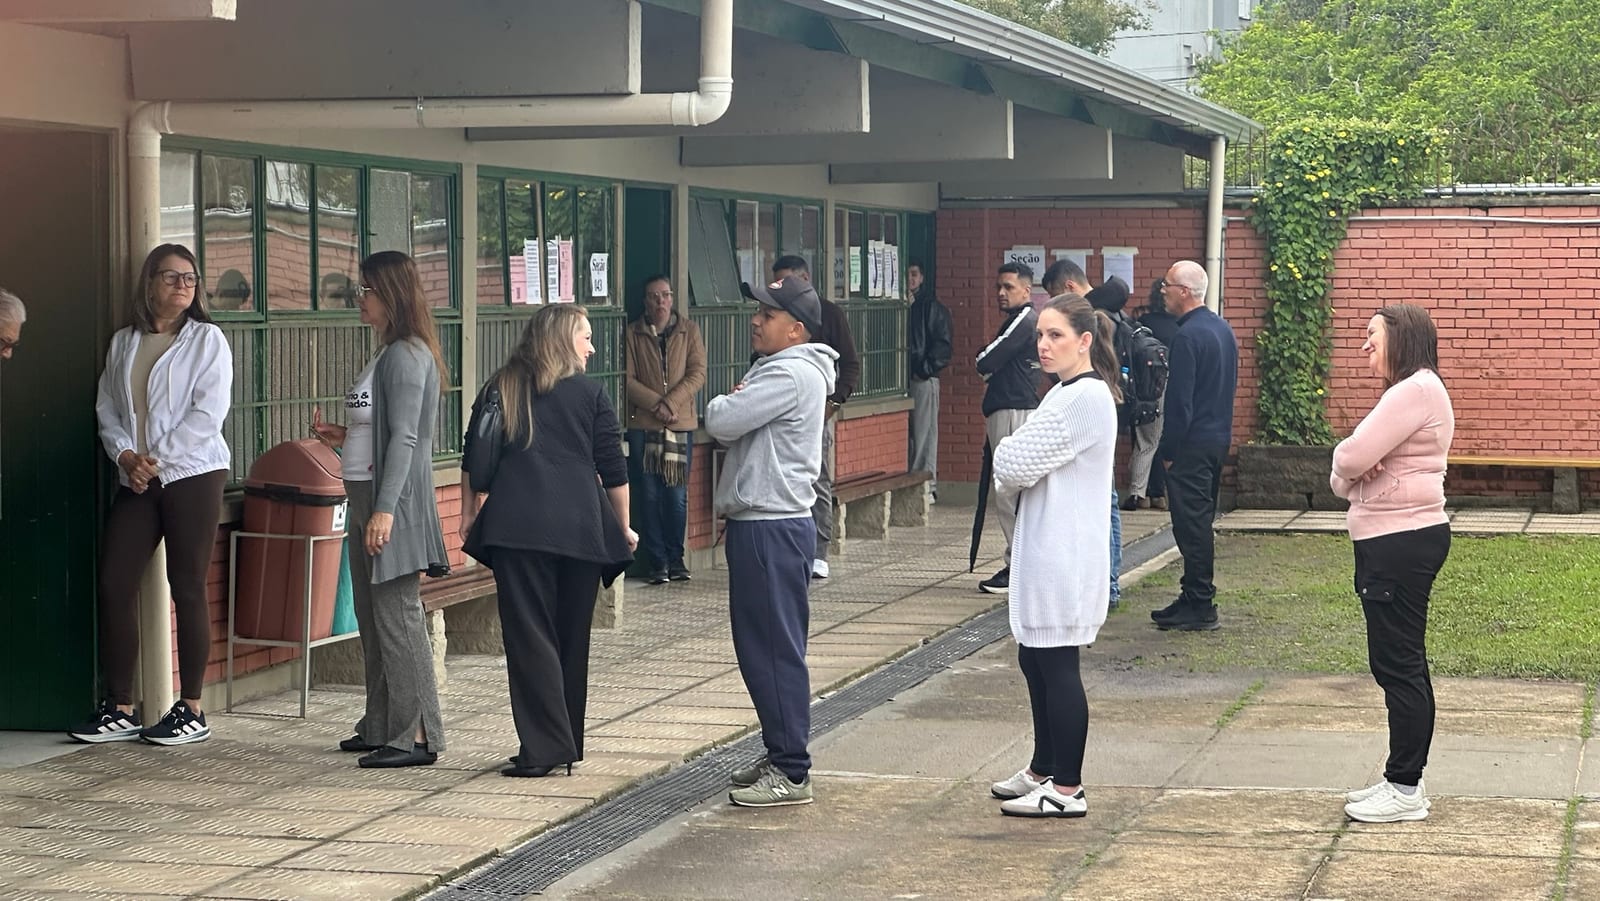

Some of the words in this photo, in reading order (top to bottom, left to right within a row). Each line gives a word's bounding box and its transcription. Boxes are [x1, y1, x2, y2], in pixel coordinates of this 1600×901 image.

[1010, 252, 1040, 264] Seção
[360, 391, 369, 399] &
[771, 784, 790, 798] N
